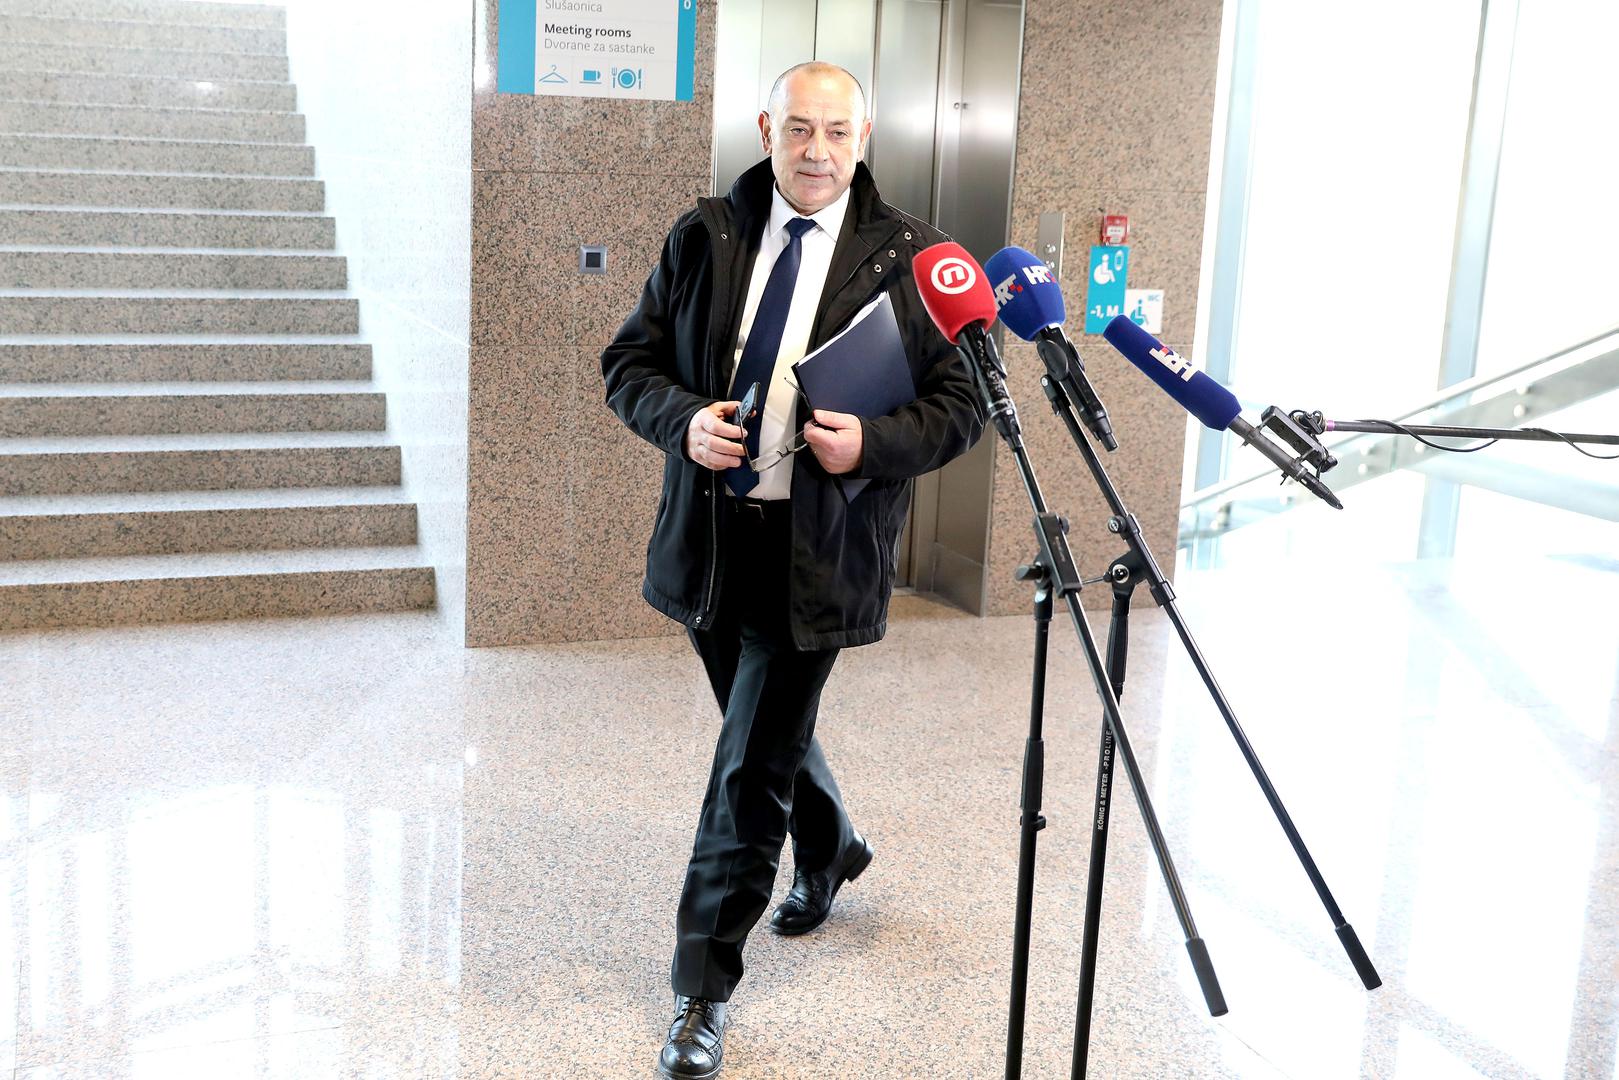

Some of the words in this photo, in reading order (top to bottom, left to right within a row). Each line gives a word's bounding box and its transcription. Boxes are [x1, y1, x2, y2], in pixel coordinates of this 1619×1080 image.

[545, 0, 603, 13] Slušaonica
[544, 23, 592, 38] Meeting
[595, 27, 632, 38] rooms
[544, 38, 591, 51] Dvorane
[593, 42, 606, 52] za
[608, 42, 656, 55] sastanke
[1106, 305, 1119, 316] M
[1100, 773, 1109, 799] MEYER
[1097, 807, 1106, 830] KÖNIG
